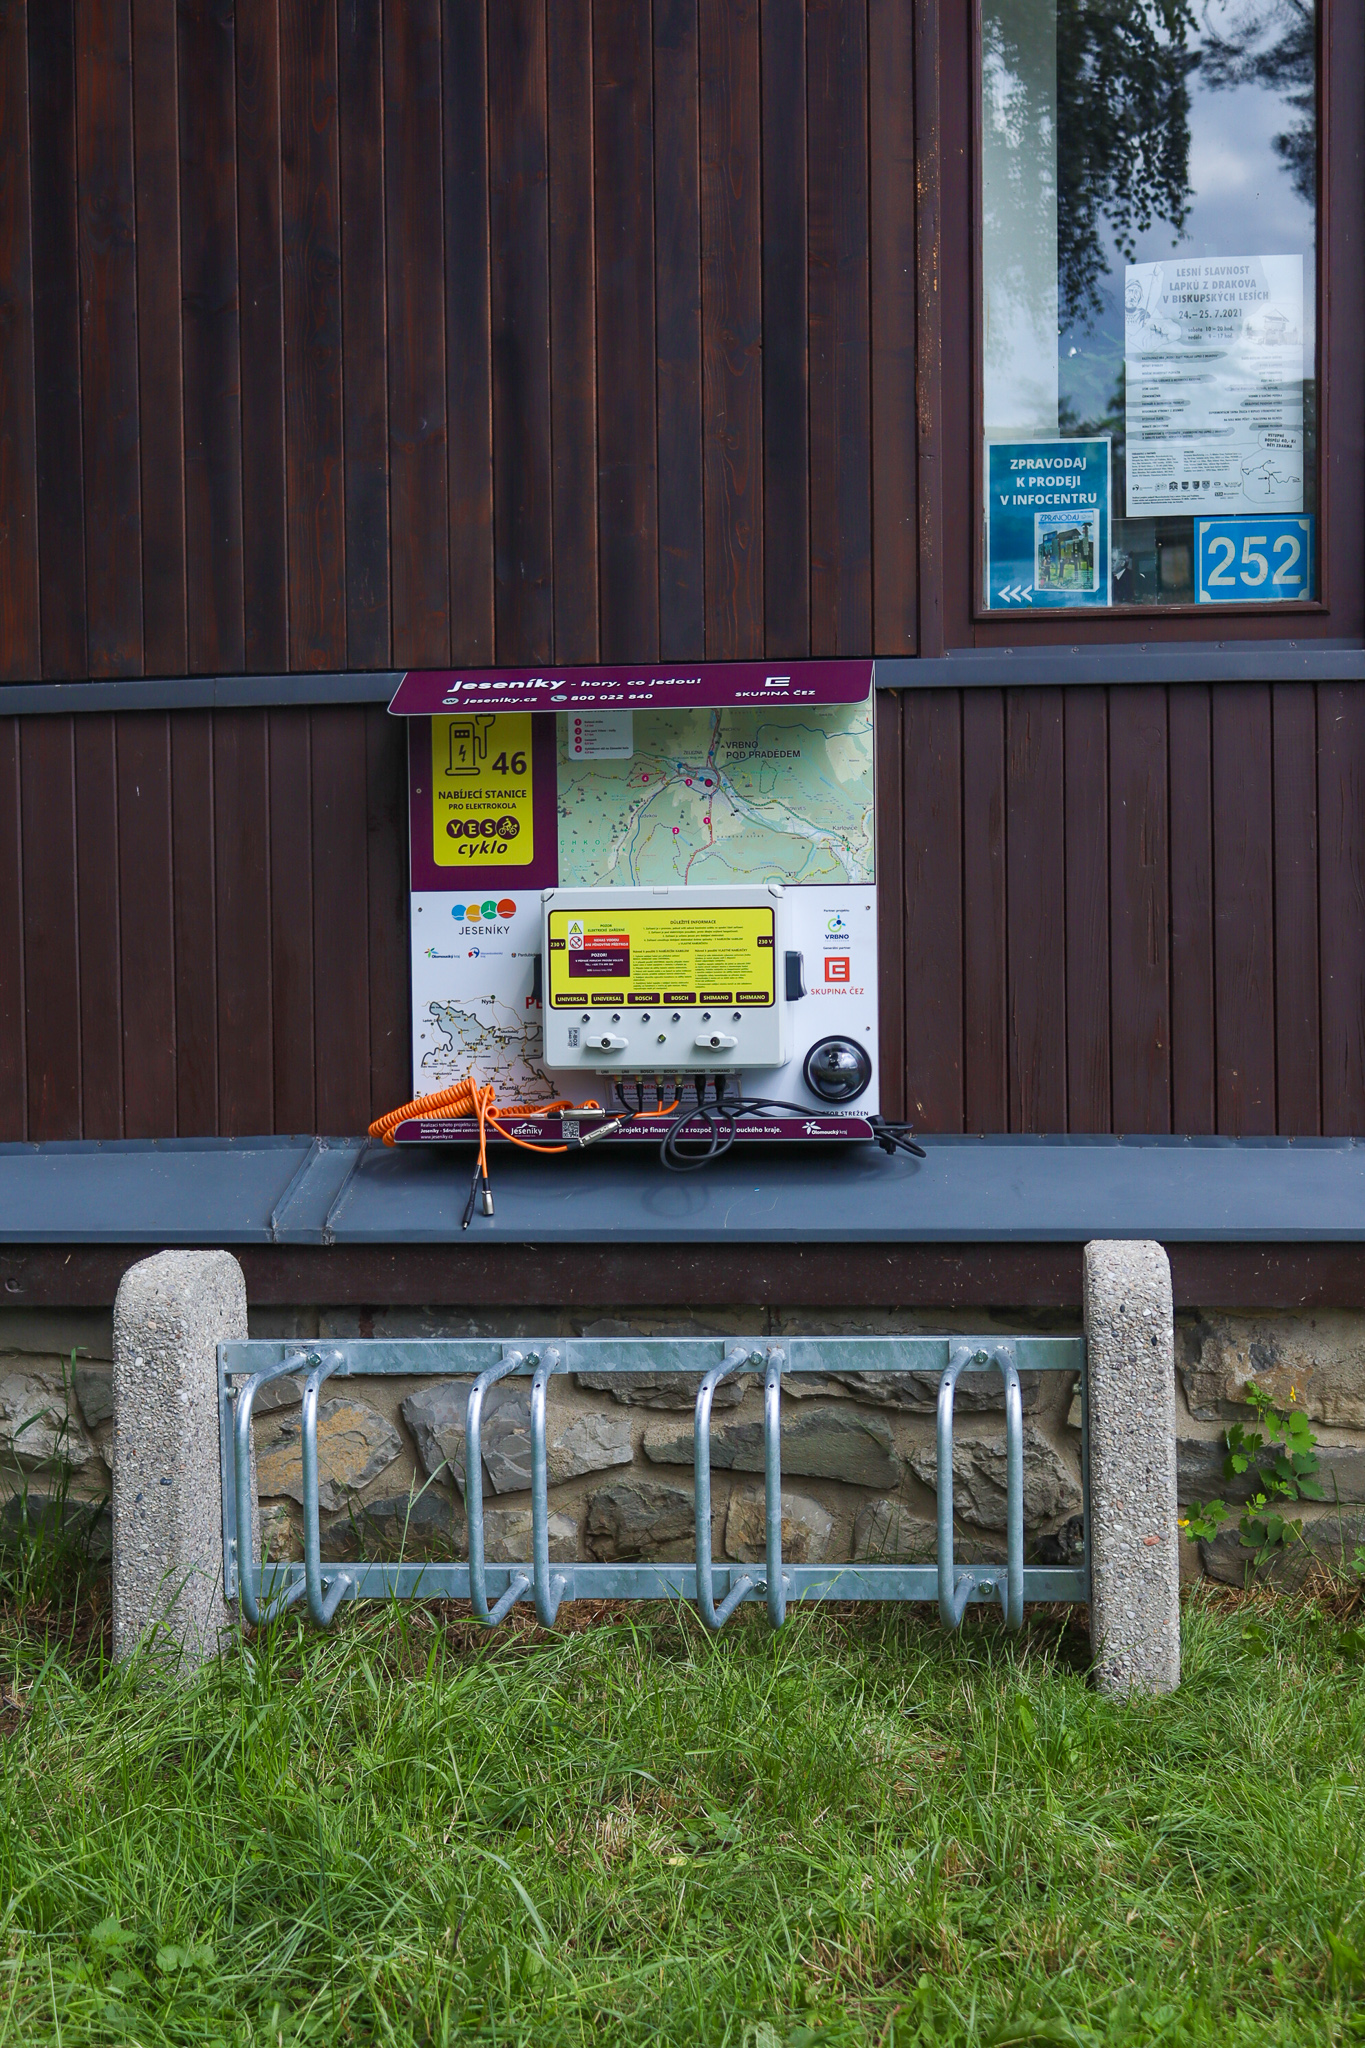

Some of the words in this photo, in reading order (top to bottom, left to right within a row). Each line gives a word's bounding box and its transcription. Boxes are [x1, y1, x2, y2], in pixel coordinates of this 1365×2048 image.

[1176, 265, 1201, 277] LESNÍ
[1204, 266, 1250, 276] SLAVNOST
[1169, 280, 1199, 291] LAPKŮ
[1203, 281, 1209, 290] Z
[1212, 279, 1257, 289] DRAKOVA
[1163, 295, 1169, 304] V
[1172, 291, 1235, 303] BISKUPSKÝCH
[1239, 290, 1269, 301] LESÍCH
[1010, 457, 1087, 470] ZPRAVODAJ
[1017, 477, 1025, 488] K
[1029, 476, 1081, 488] PRODEJI
[1000, 494, 1009, 505] V
[1013, 492, 1097, 506] INFOCENTRU
[1207, 535, 1301, 586] 252
[447, 679, 566, 693] Jeseníky
[649, 678, 702, 687] jedou!
[726, 741, 759, 749] VRBNO
[726, 751, 746, 759] POD
[749, 749, 801, 758] PRADĚDEM
[492, 751, 527, 775] 46
[438, 788, 483, 800] NABÍJECÍ
[485, 789, 527, 798] STANICE
[466, 802, 517, 810] ELEKTROKOLA
[448, 820, 494, 836] YES
[457, 840, 508, 858] cyklo
[458, 924, 510, 936] JESENÍKY
[849, 986, 864, 995] ČEZ
